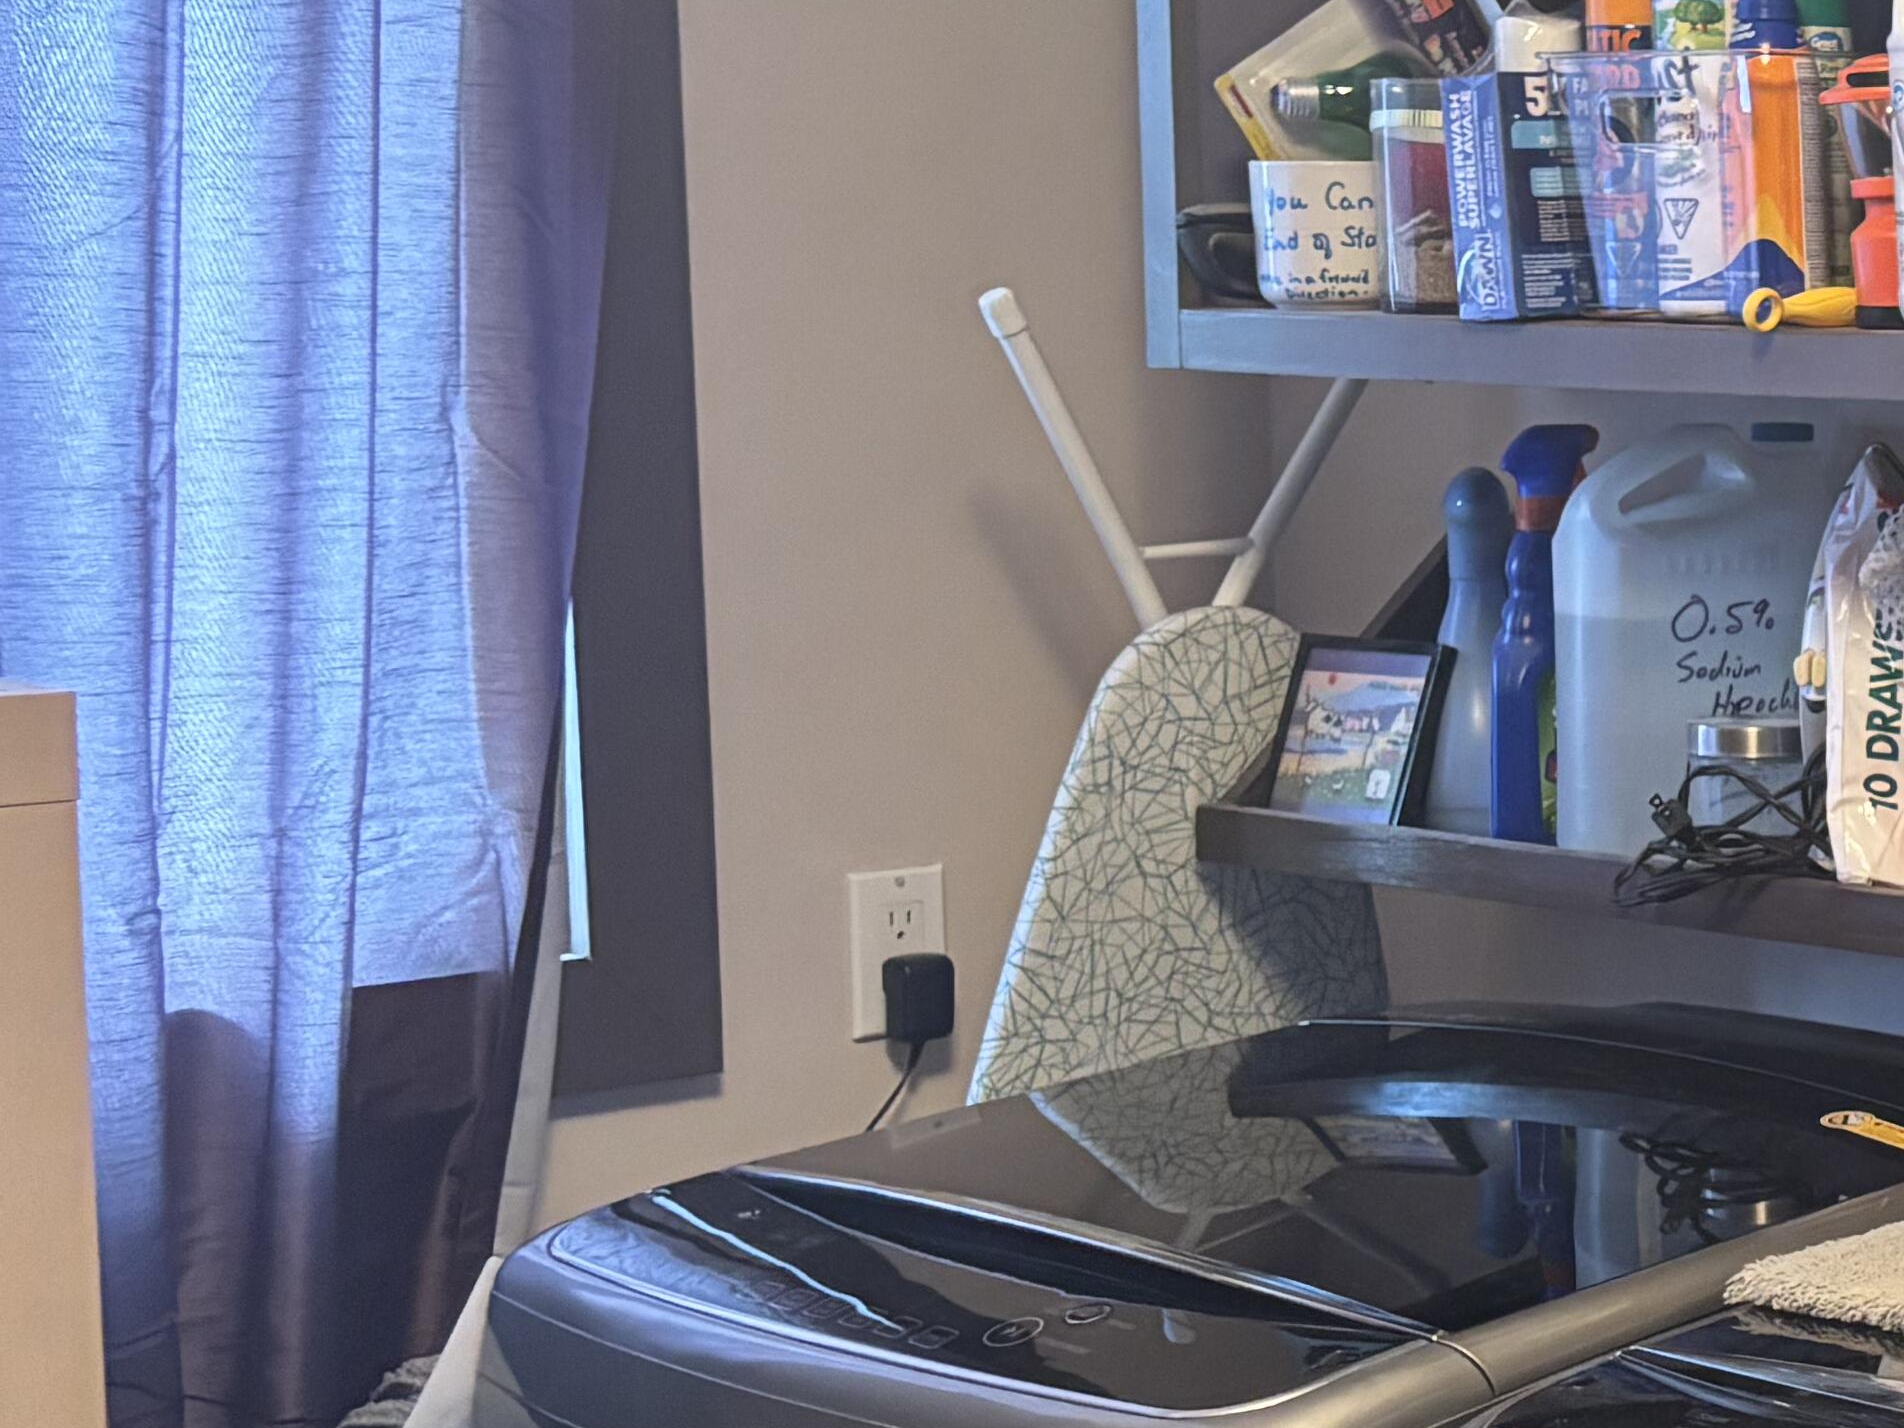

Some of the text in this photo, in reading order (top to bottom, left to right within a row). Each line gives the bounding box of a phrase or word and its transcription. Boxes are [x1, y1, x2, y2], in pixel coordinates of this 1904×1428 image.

[1449, 93, 1469, 227] POWERWASH
[1460, 90, 1482, 230] SUPERLAVAGE
[1340, 225, 1377, 249] Sto
[1475, 229, 1500, 311] DAWN
[1671, 594, 1775, 643] 0.5%
[1676, 650, 1761, 683] Sodium
[1862, 772, 1899, 811] 10
